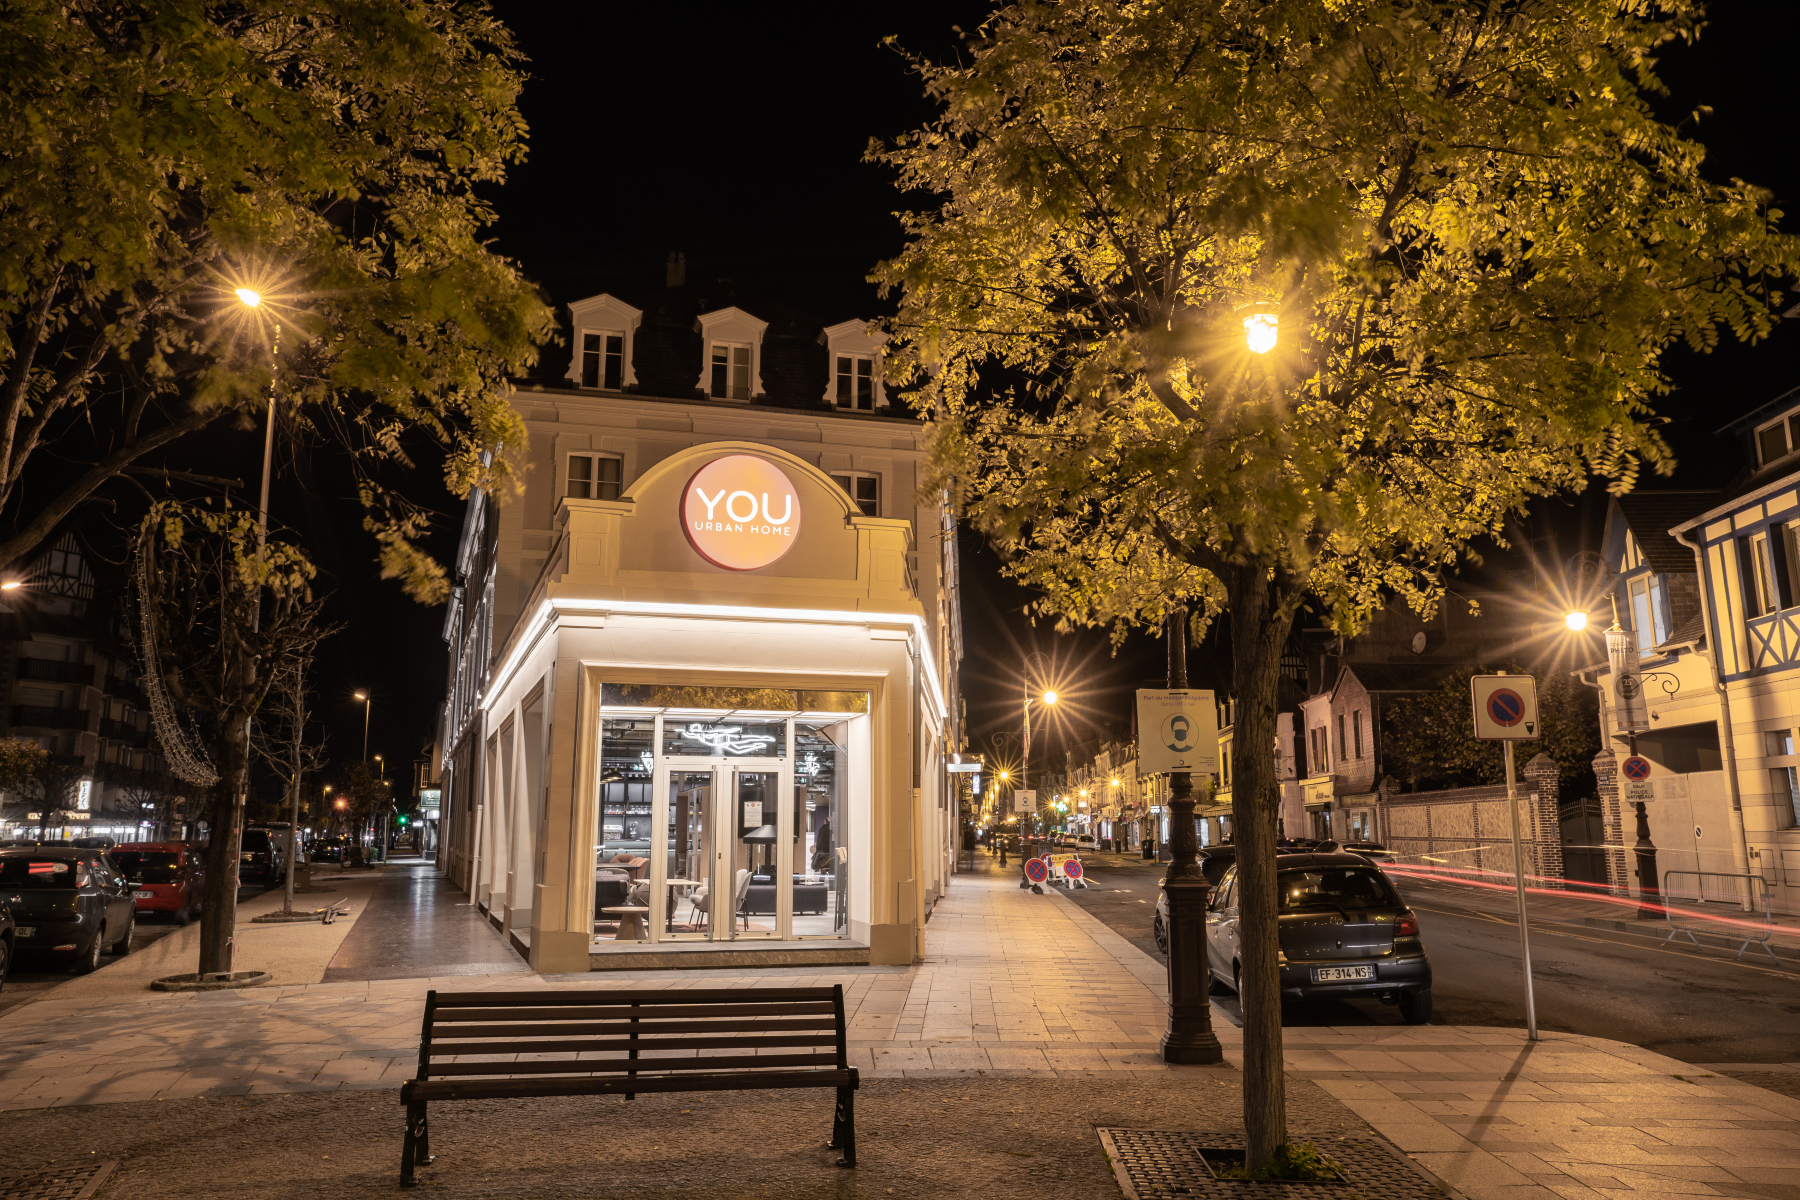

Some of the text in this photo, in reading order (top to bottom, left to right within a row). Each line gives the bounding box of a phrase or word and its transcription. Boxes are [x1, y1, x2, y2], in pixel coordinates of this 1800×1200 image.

[695, 487, 792, 525] YOU
[694, 521, 791, 536] URBAN HOME
